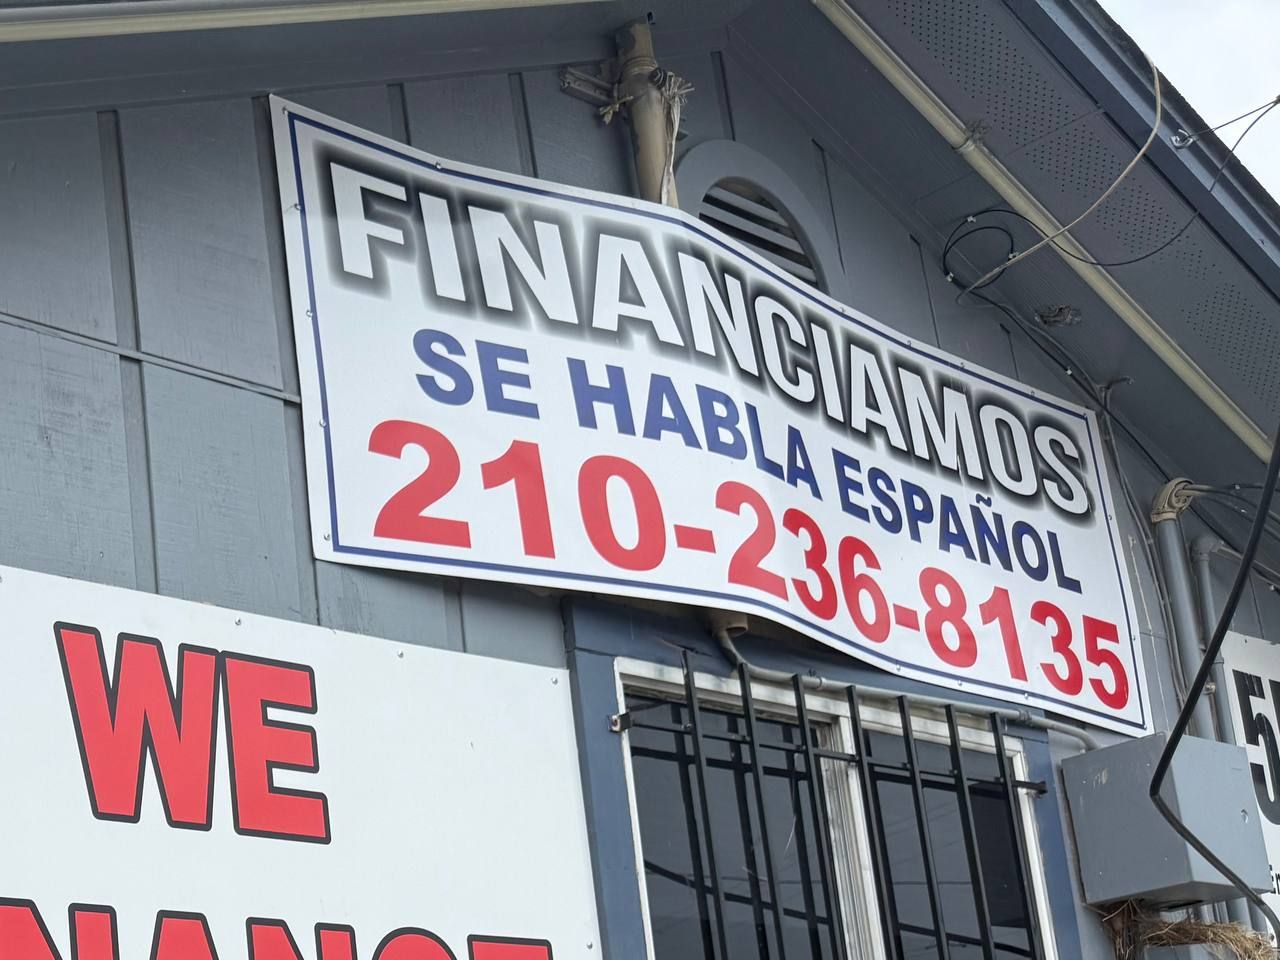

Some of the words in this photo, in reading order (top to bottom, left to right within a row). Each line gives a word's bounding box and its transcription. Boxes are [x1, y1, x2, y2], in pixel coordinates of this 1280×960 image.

[326, 156, 1093, 520] FINANCIAMOS
[413, 328, 540, 421] SE
[567, 357, 823, 501] HABLA
[831, 447, 1083, 594] ESPAÑOL
[366, 418, 1131, 711] 210-236-8135
[53, 619, 332, 845] WE
